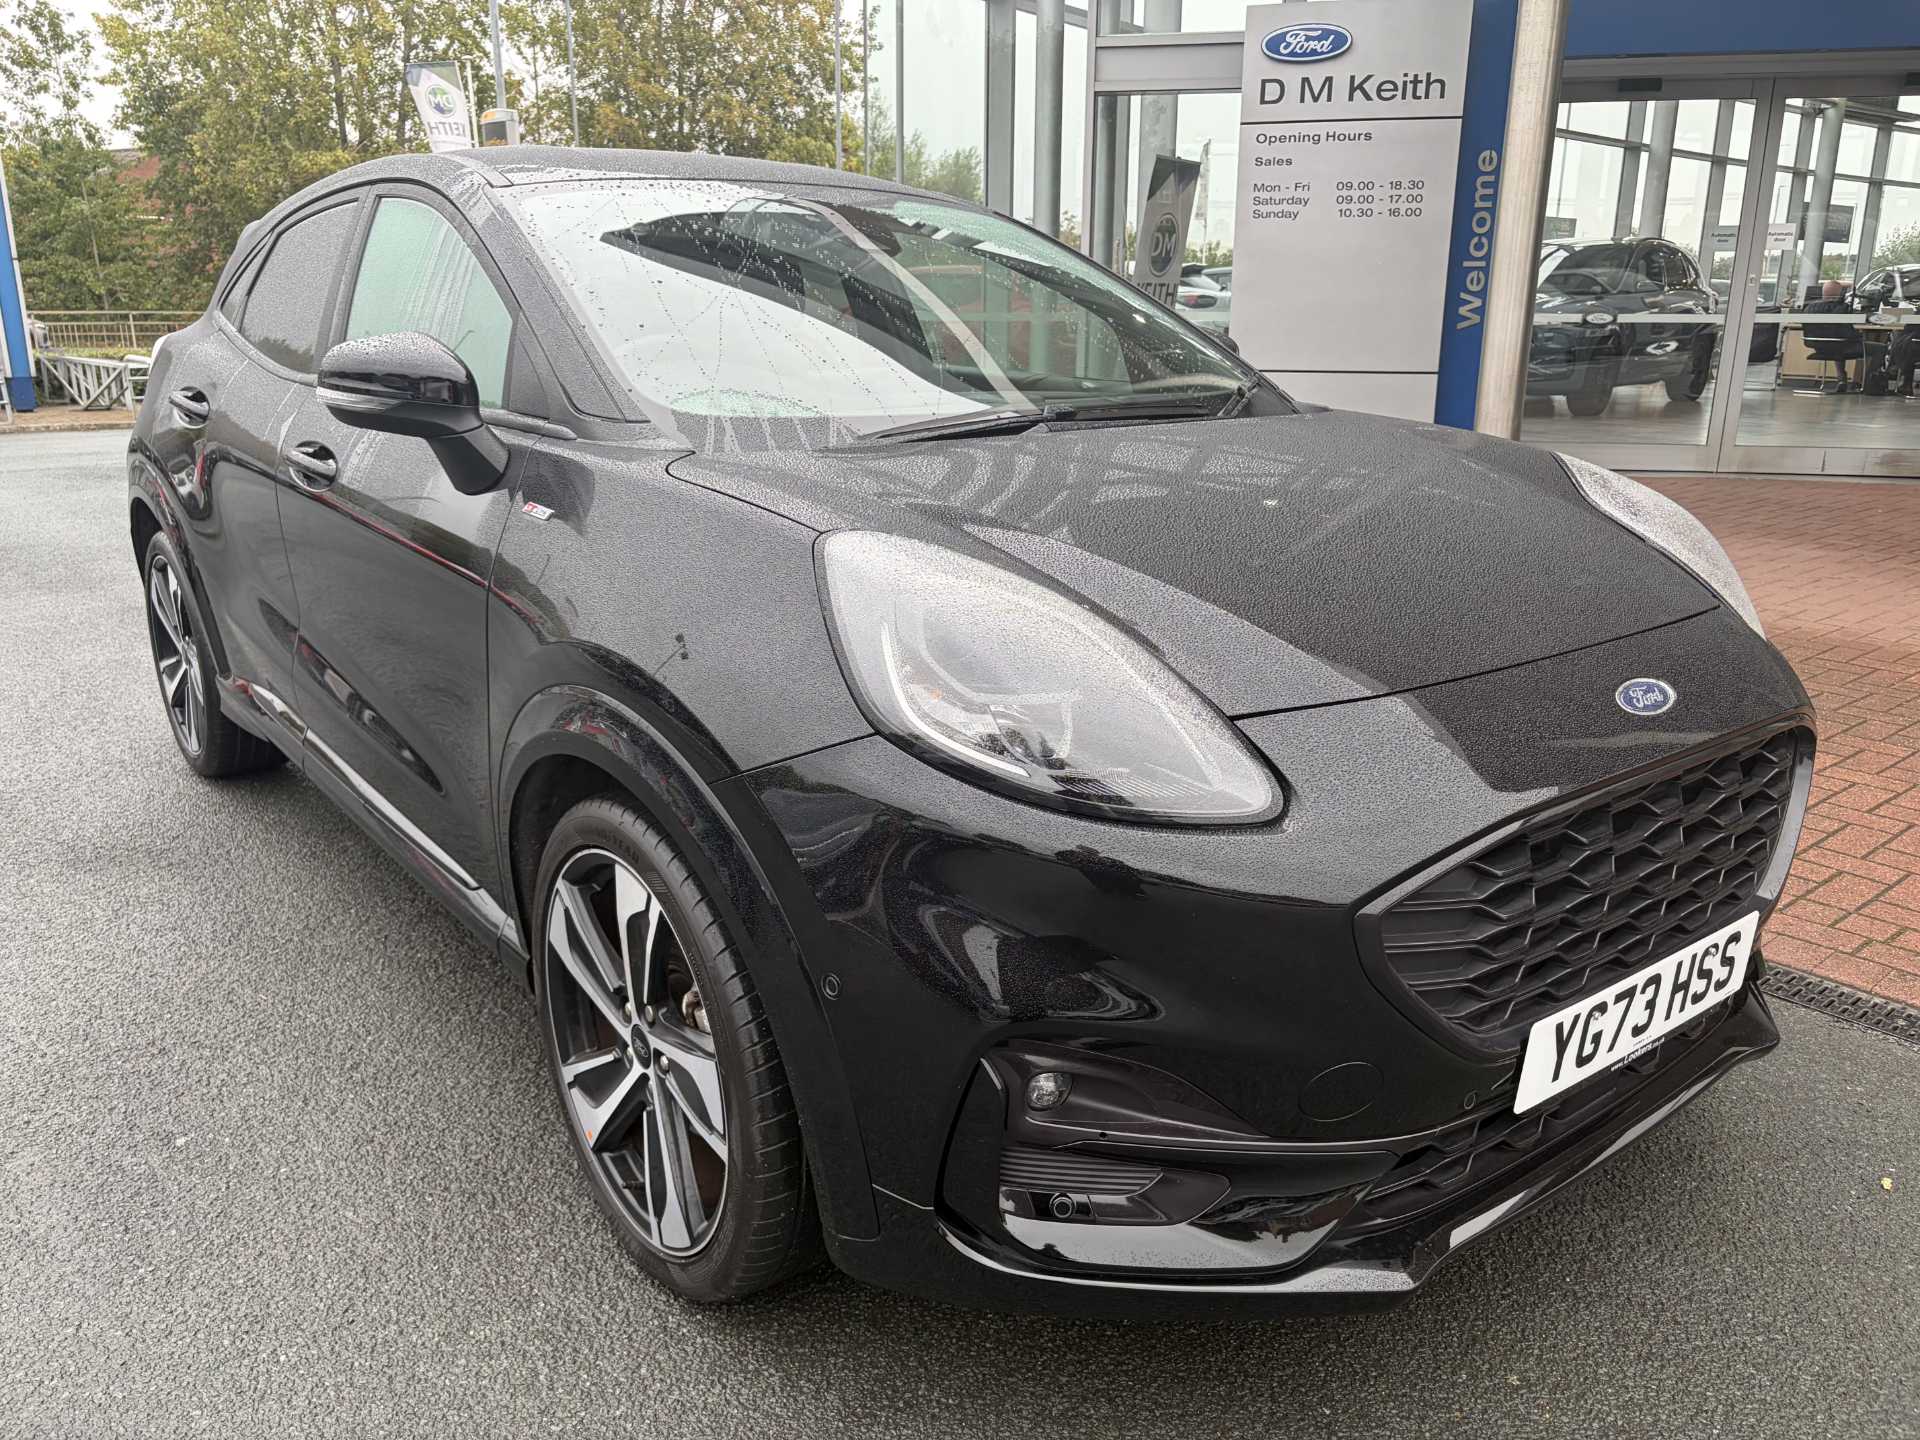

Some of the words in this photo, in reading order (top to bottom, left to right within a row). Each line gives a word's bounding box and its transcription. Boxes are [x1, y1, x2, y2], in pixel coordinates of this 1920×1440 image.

[1259, 78, 1285, 105] D
[1299, 75, 1334, 104] M
[1347, 72, 1446, 102] Keith
[1255, 131, 1321, 145] Opening
[1325, 130, 1373, 142] Hours
[1254, 156, 1293, 167] Sales
[1253, 182, 1281, 193] Mon
[1294, 181, 1311, 192] Fri
[1336, 181, 1375, 191] 09.00
[1388, 180, 1425, 190] 18.30
[1252, 195, 1310, 208] Saturday
[1336, 195, 1375, 205] 09.00
[1388, 194, 1424, 205] 17.00
[1252, 209, 1300, 221] Sunday
[1338, 208, 1374, 219] 10.30
[1387, 207, 1422, 218] 16.00
[1151, 231, 1177, 257] DM
[1456, 149, 1499, 330] Welcome
[1551, 973, 1662, 1083] YG73
[1664, 930, 1742, 1022] HSS
